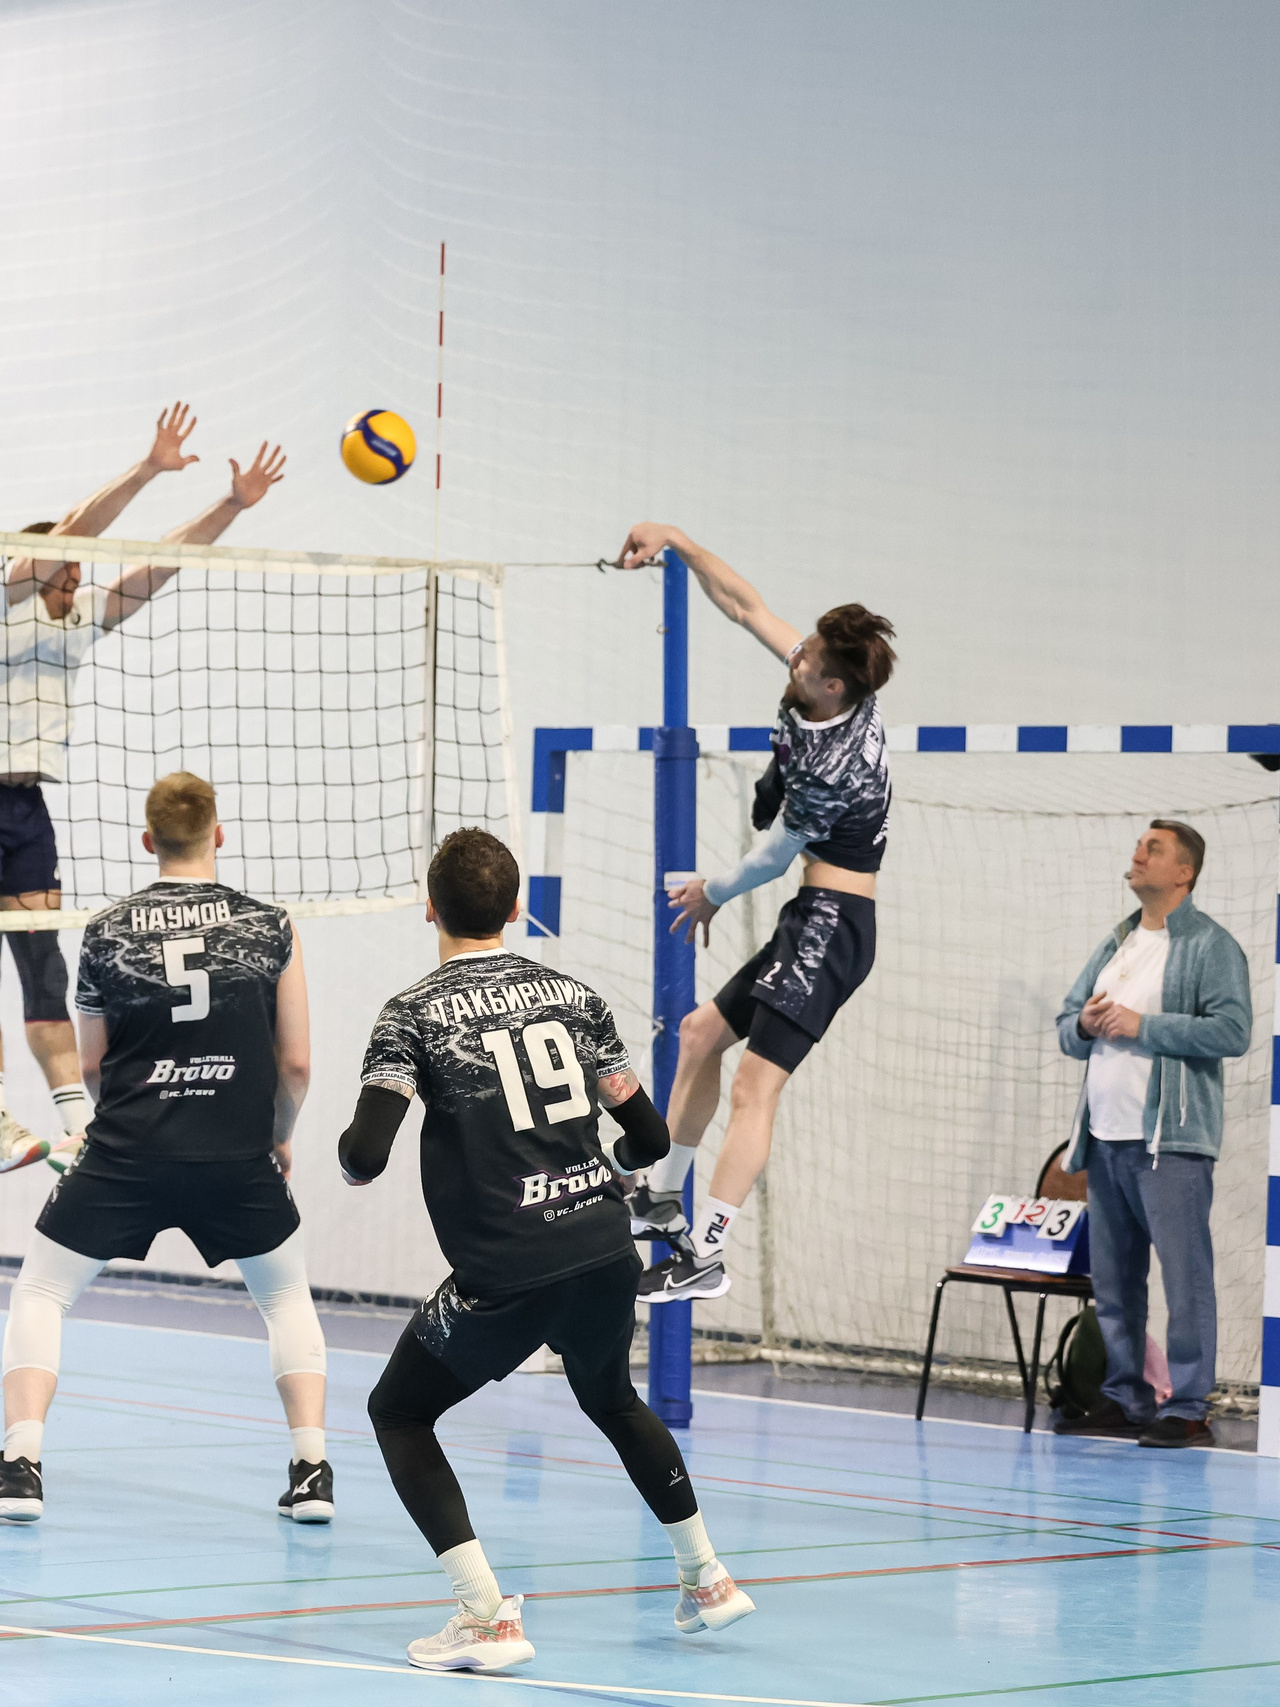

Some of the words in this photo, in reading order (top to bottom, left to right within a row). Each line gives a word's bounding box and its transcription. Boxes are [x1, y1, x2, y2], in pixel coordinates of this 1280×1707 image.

[131, 899, 232, 932] НАУМОВ
[161, 936, 211, 1024] 5
[430, 979, 587, 1028] ТАКБИРШИН
[146, 1059, 236, 1083] Bravo
[480, 1020, 591, 1133] 19
[704, 1212, 730, 1245] FILA
[980, 1202, 1005, 1230] 3
[1013, 1203, 1025, 1221] 1
[1025, 1204, 1047, 1223] 2
[1046, 1209, 1072, 1237] 3
